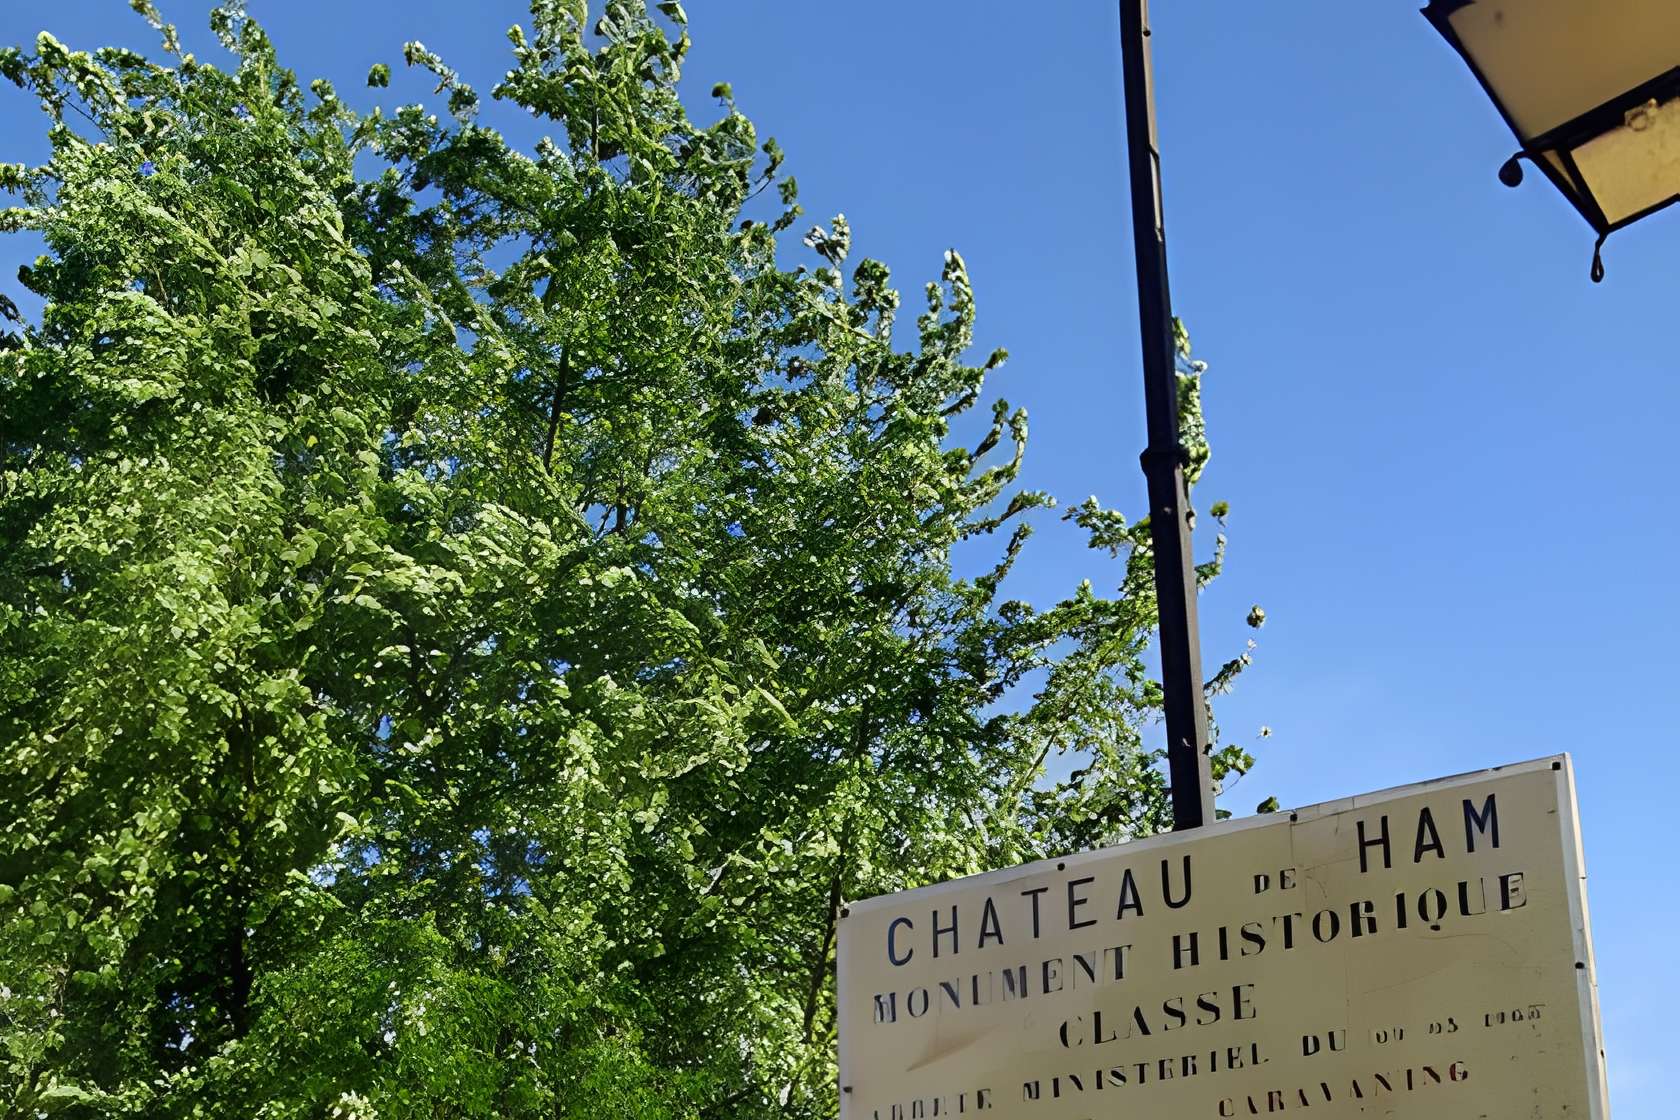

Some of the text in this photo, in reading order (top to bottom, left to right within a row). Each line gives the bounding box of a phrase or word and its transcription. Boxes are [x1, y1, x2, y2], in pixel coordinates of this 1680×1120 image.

[888, 793, 1499, 966] CHATEAU DE HAM
[874, 872, 1527, 1024] MONUMENT HISTORIQUE
[1059, 984, 1256, 1048] CLASSE
[1302, 1029, 1346, 1056] DU
